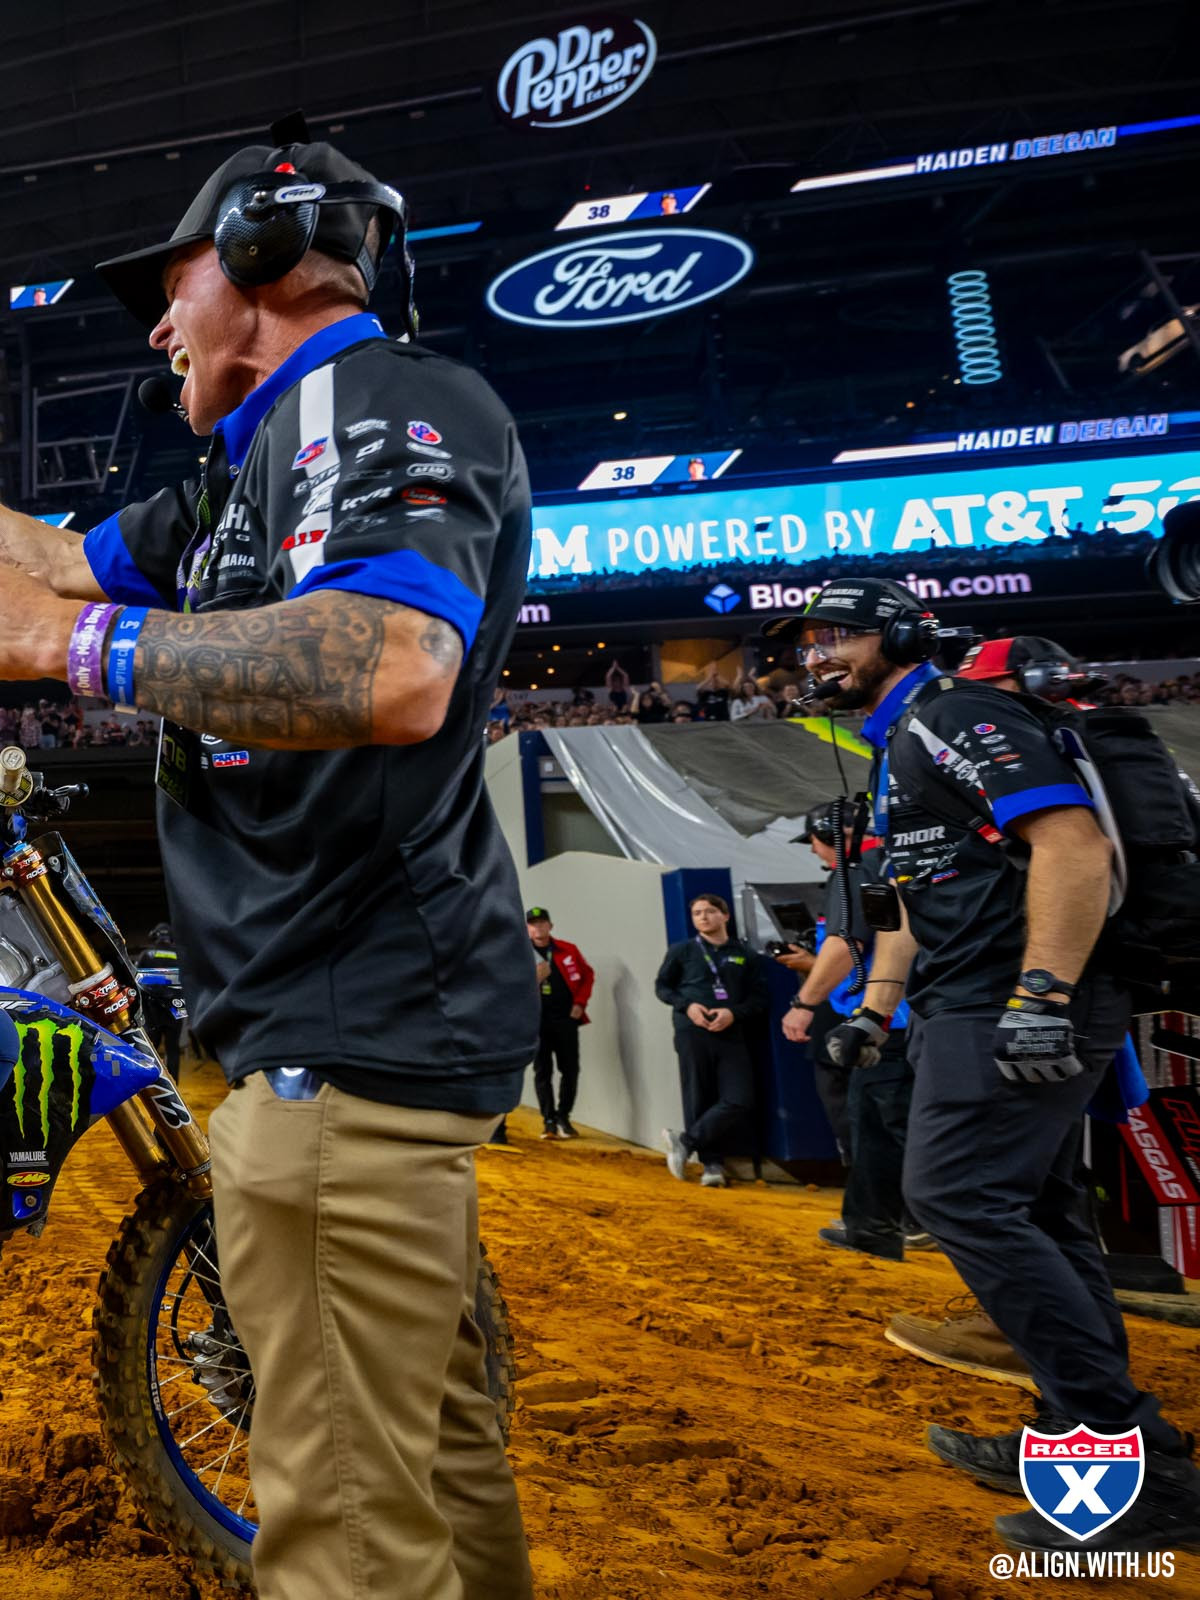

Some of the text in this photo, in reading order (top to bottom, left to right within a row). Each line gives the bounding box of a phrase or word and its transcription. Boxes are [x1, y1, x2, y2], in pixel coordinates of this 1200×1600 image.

[555, 24, 615, 76] Dr
[915, 126, 1117, 174] HAIDEN DEEGAN
[586, 203, 611, 221] 38
[533, 241, 704, 316] Ford
[956, 411, 1169, 452] HAIDEN DEEGAN
[611, 465, 636, 482] 38
[607, 513, 808, 567] POWERED
[824, 507, 876, 551] BY
[892, 485, 1084, 550] AT&T
[892, 825, 946, 848] THOR
[104, 995, 129, 1016] ROCS
[9, 1150, 47, 1162] YAMALUBE
[7, 1172, 51, 1186] FMF
